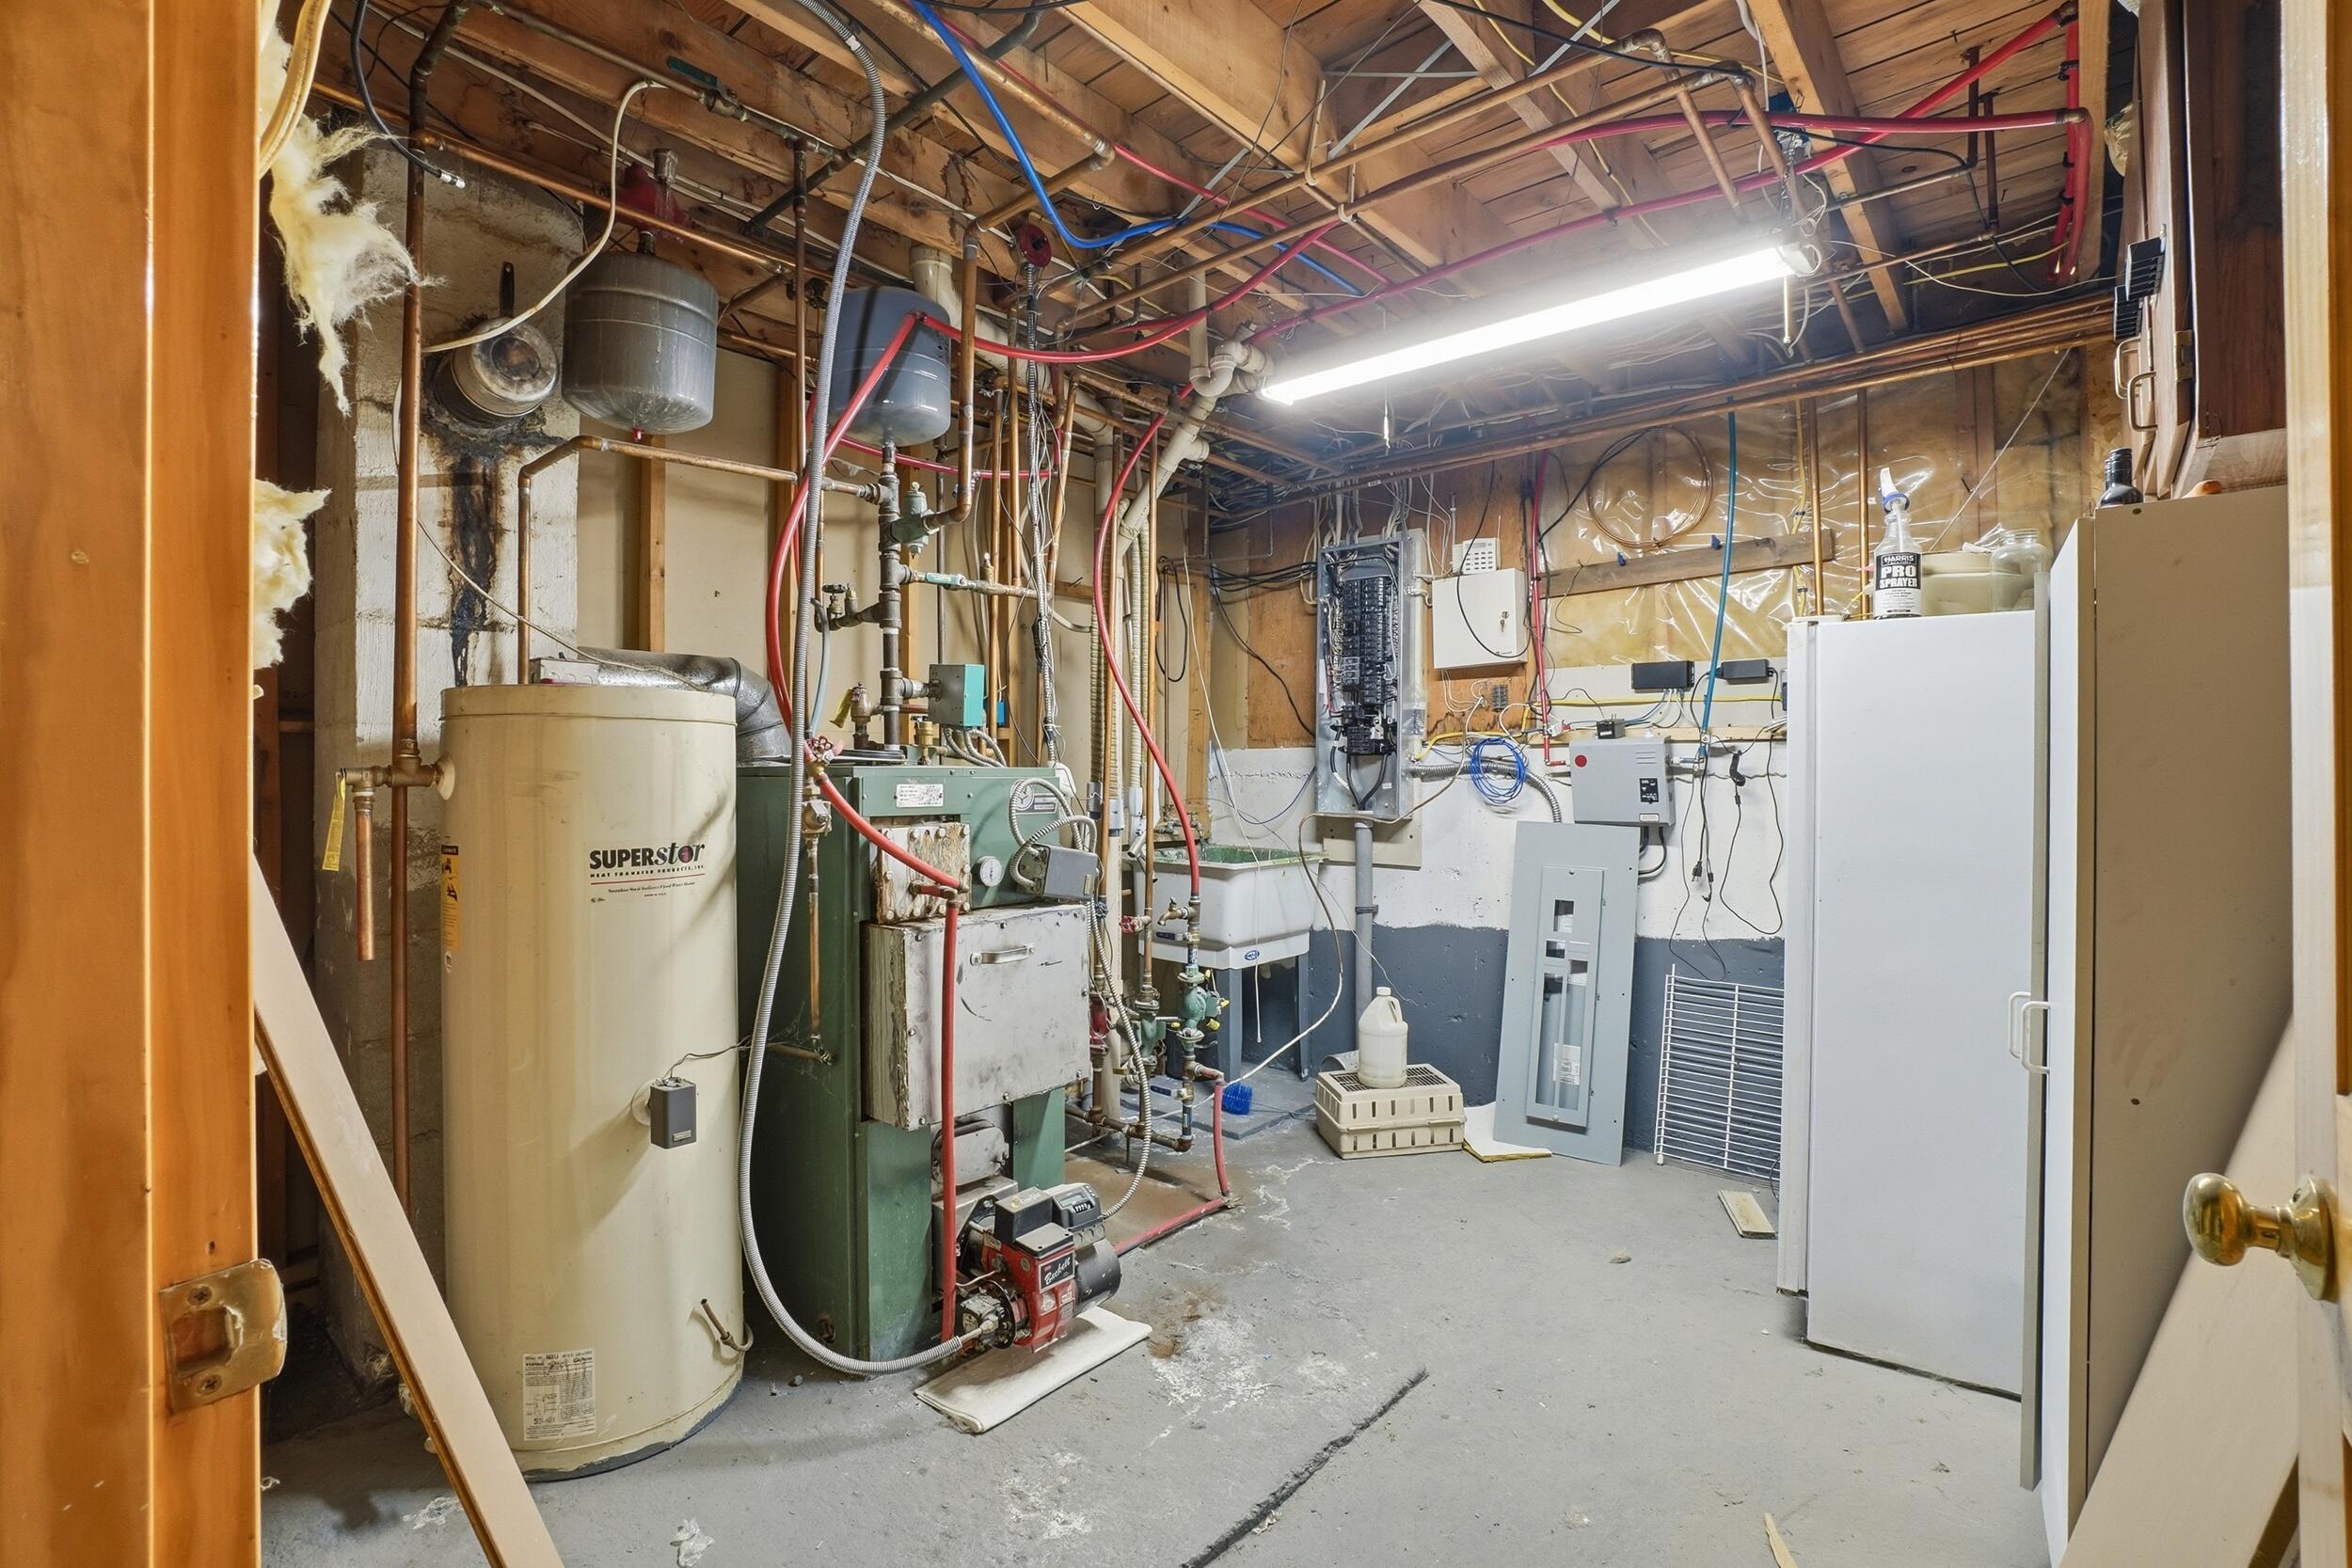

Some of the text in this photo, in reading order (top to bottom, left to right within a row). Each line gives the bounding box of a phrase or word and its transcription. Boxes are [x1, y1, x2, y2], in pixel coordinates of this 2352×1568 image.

[1881, 565, 1916, 578] PRO
[1880, 578, 1917, 588] SPRAYER
[1044, 1257, 1071, 1285] Beckett
